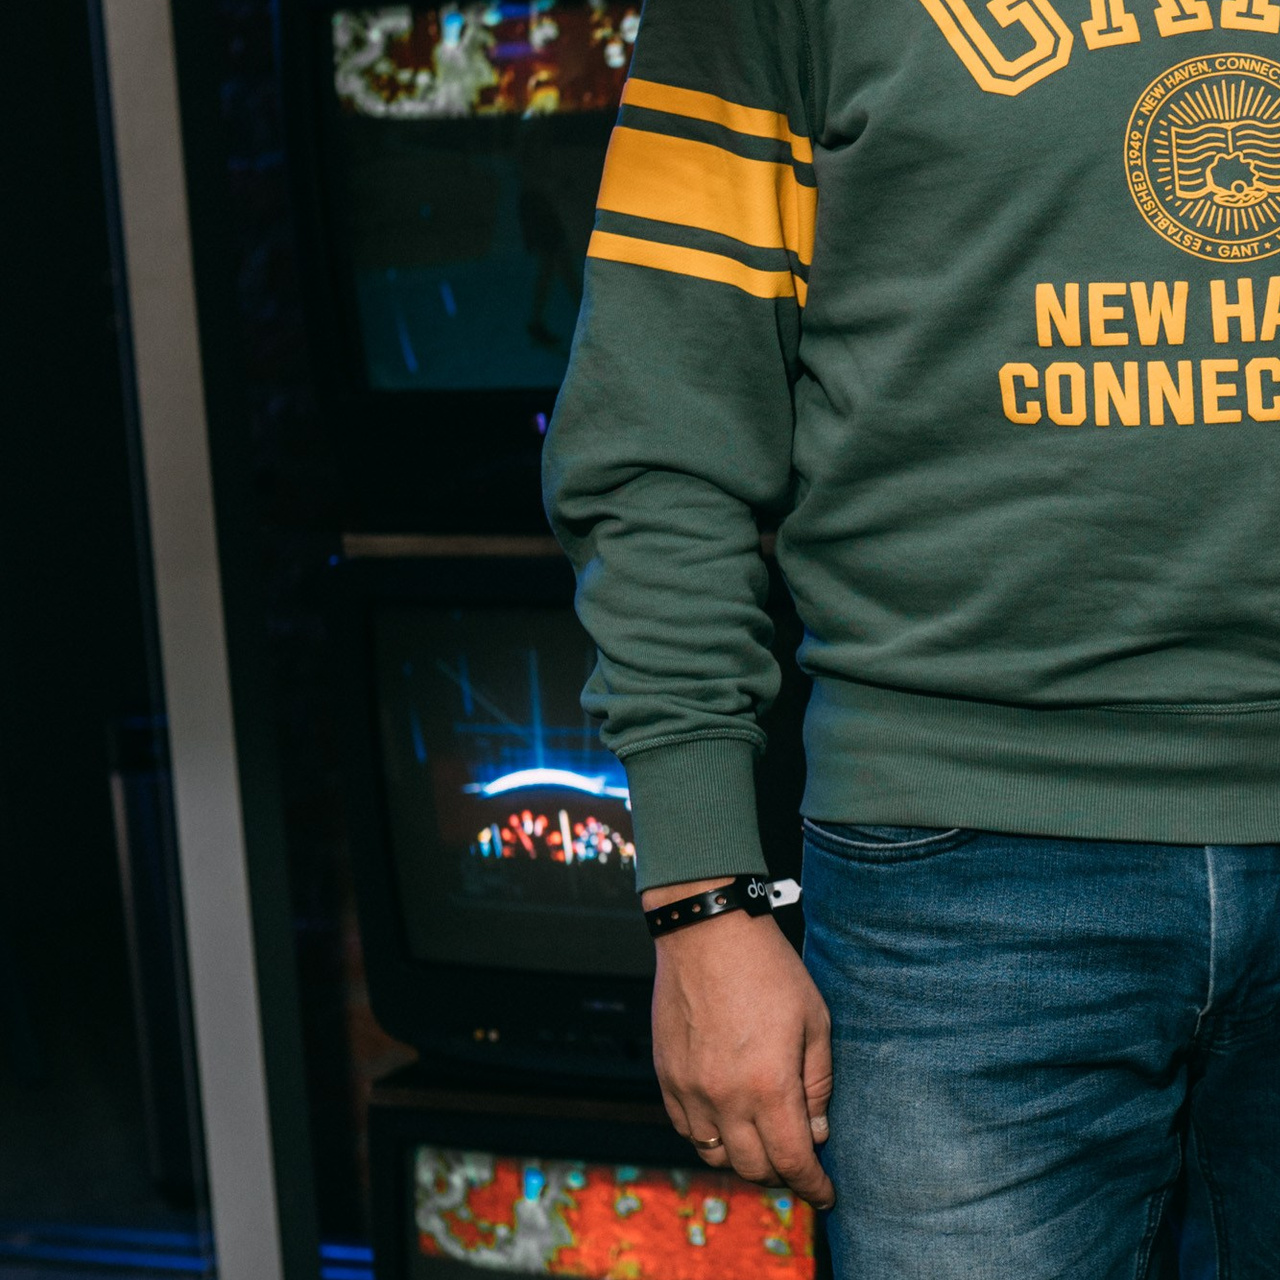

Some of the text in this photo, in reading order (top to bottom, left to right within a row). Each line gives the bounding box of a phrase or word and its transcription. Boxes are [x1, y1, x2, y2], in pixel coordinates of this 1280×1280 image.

[1139, 84, 1166, 116] NEW
[1165, 60, 1212, 89] HAVEN,
[1128, 130, 1203, 252] ESTABLISHED 1949
[1218, 242, 1260, 258] GANT
[1034, 280, 1189, 348] NEW
